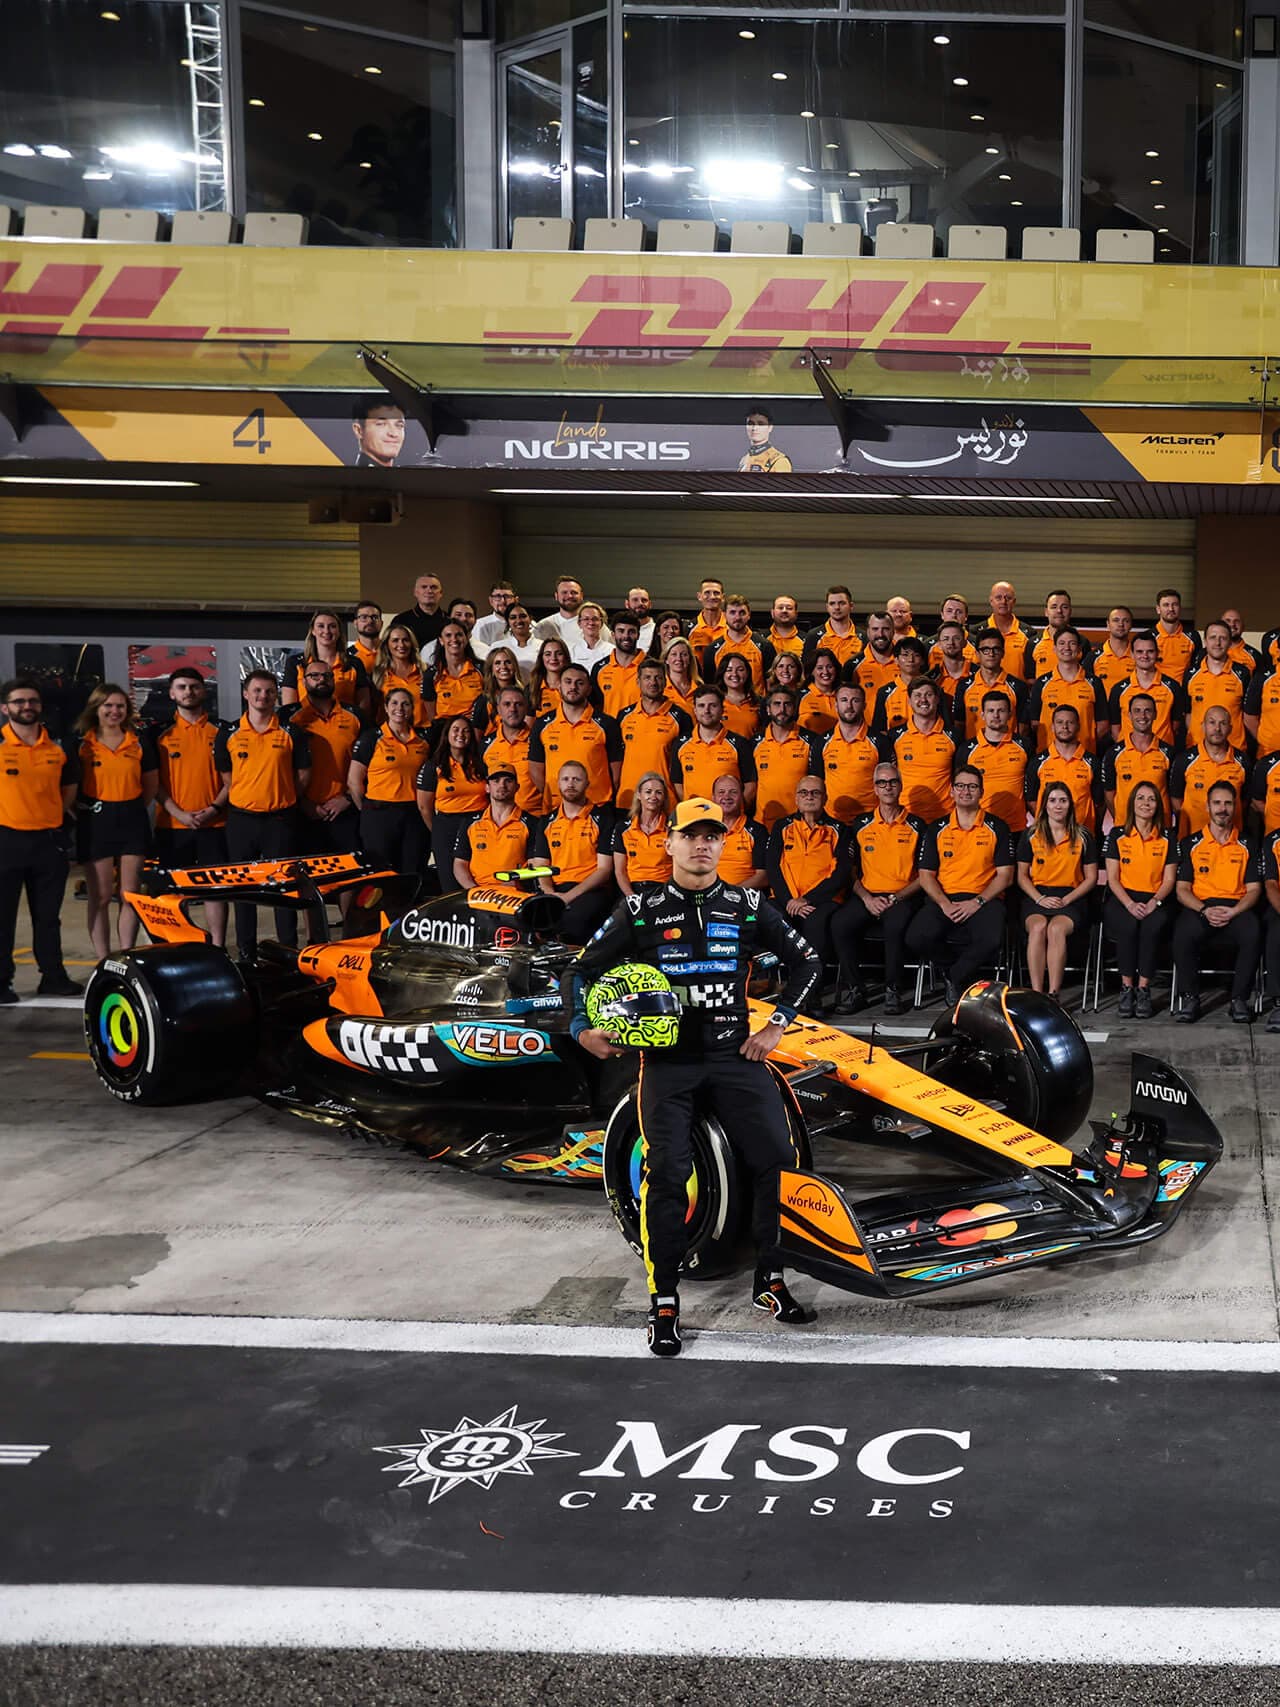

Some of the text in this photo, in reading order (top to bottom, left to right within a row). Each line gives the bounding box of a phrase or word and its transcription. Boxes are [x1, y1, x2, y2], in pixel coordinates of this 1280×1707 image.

[563, 275, 1010, 371] DHL
[233, 408, 271, 454] 4
[556, 404, 607, 447] Lando
[504, 440, 690, 461] NORRIS
[857, 417, 1028, 468] نوريس
[1141, 435, 1217, 446] McLaren
[401, 909, 475, 951] Gemini
[655, 913, 685, 925] Android
[338, 954, 365, 971] DELL
[710, 944, 736, 954] allwyn
[453, 1025, 545, 1056] VELO
[978, 1120, 1014, 1136] FxPro
[787, 1194, 835, 1217] workday
[579, 1421, 972, 1486] MSC
[559, 1491, 956, 1519] CRUISES
